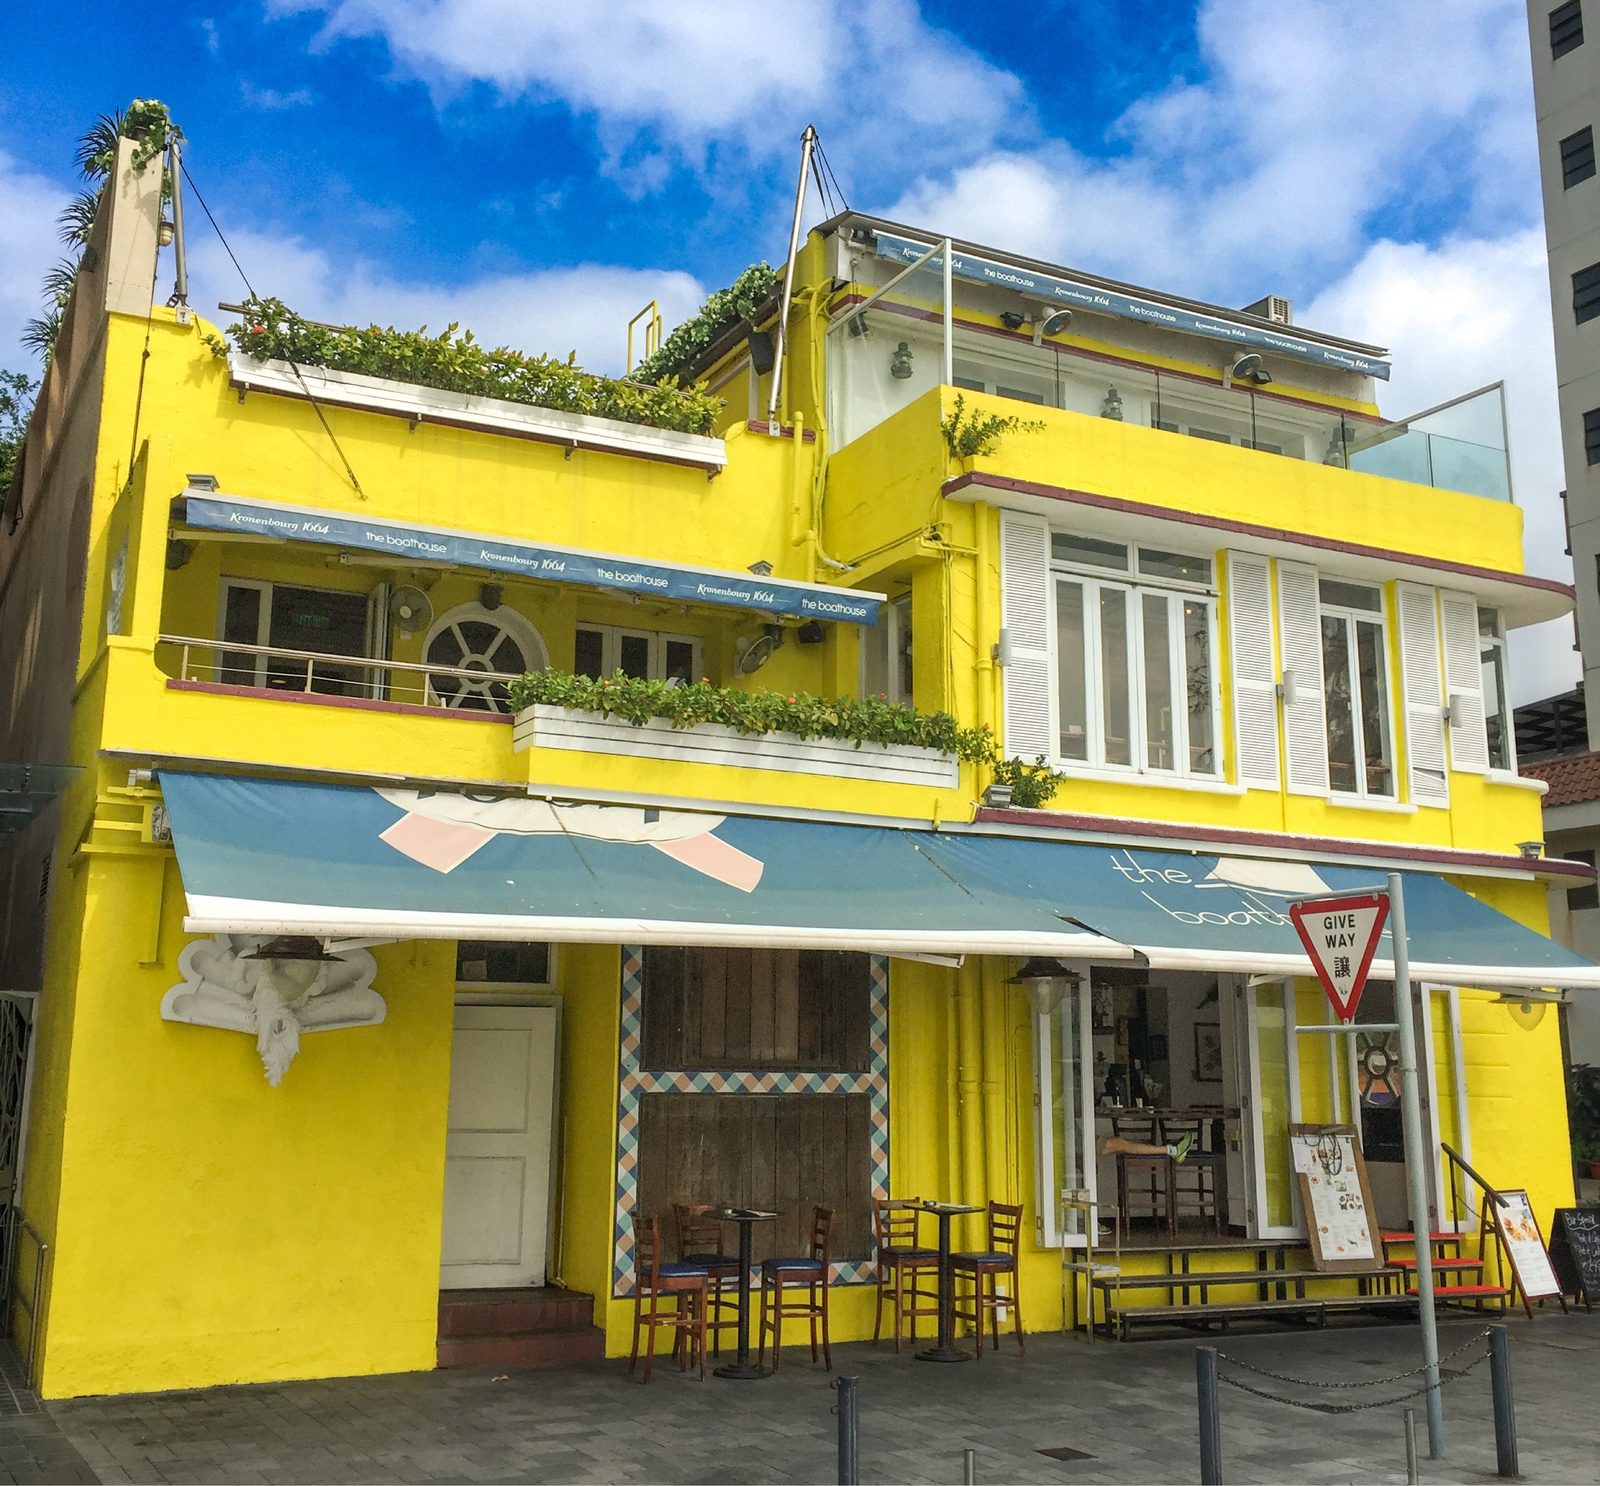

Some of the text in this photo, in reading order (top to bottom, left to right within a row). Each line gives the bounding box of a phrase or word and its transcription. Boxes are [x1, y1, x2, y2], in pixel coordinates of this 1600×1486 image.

[984, 268, 1035, 288] the boathouse
[1054, 286, 1093, 303] Kronenbourg
[1129, 305, 1141, 314] the
[229, 512, 330, 535] Kronenbourg 1664
[366, 531, 448, 553] the boathouse
[480, 549, 566, 572] Kronenbourg 1664
[597, 567, 669, 588] the boathouse
[697, 584, 775, 604] Kronenbourg 1664
[802, 598, 867, 617] the boathouse
[1110, 849, 1192, 884] the
[1323, 914, 1356, 930] GIVE
[1325, 933, 1356, 949] WAY
[1333, 955, 1351, 978] 讓
